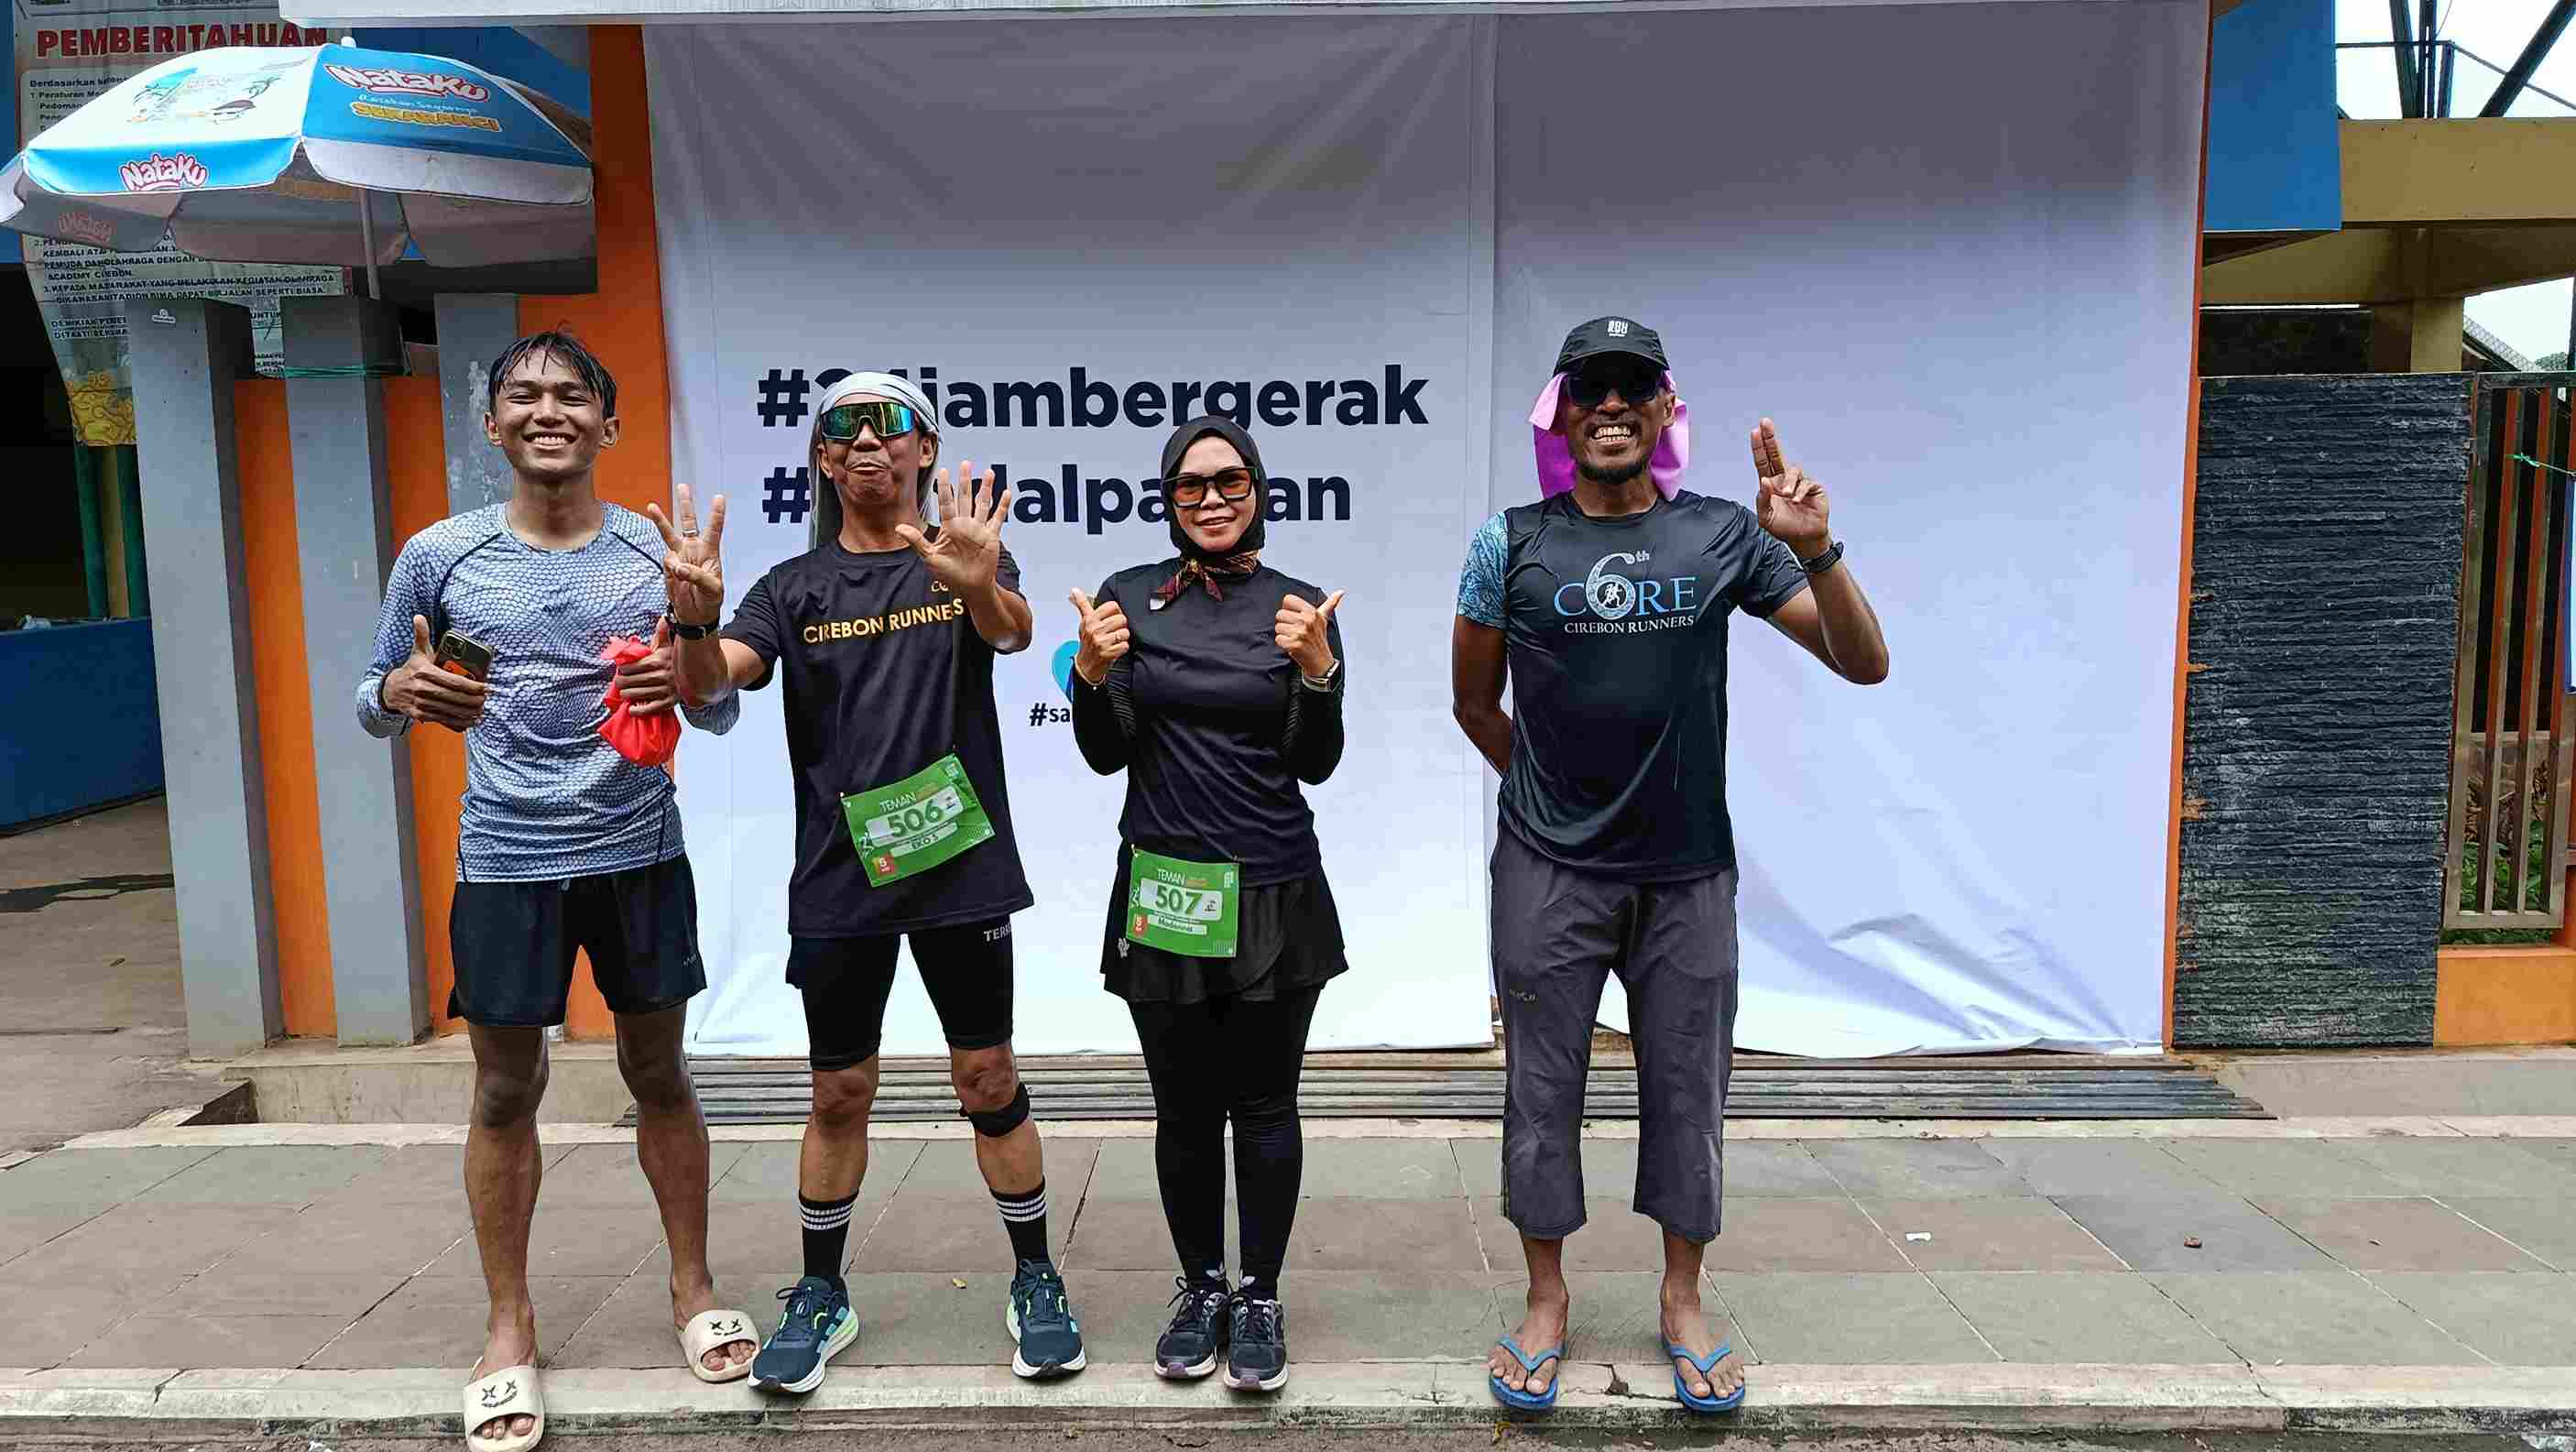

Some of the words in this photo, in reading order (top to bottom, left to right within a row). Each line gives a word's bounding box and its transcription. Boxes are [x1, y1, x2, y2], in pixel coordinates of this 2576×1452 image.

[37, 23, 327, 58] PEMBERITAHUAN
[119, 152, 208, 190] NataKu
[803, 616, 884, 643] CIREBON
[890, 597, 965, 631] RUNNES
[1564, 621, 1625, 634] CIREBON
[1628, 616, 1694, 634] RUNNERS
[887, 798, 944, 838] 506
[1155, 884, 1203, 915] 507
